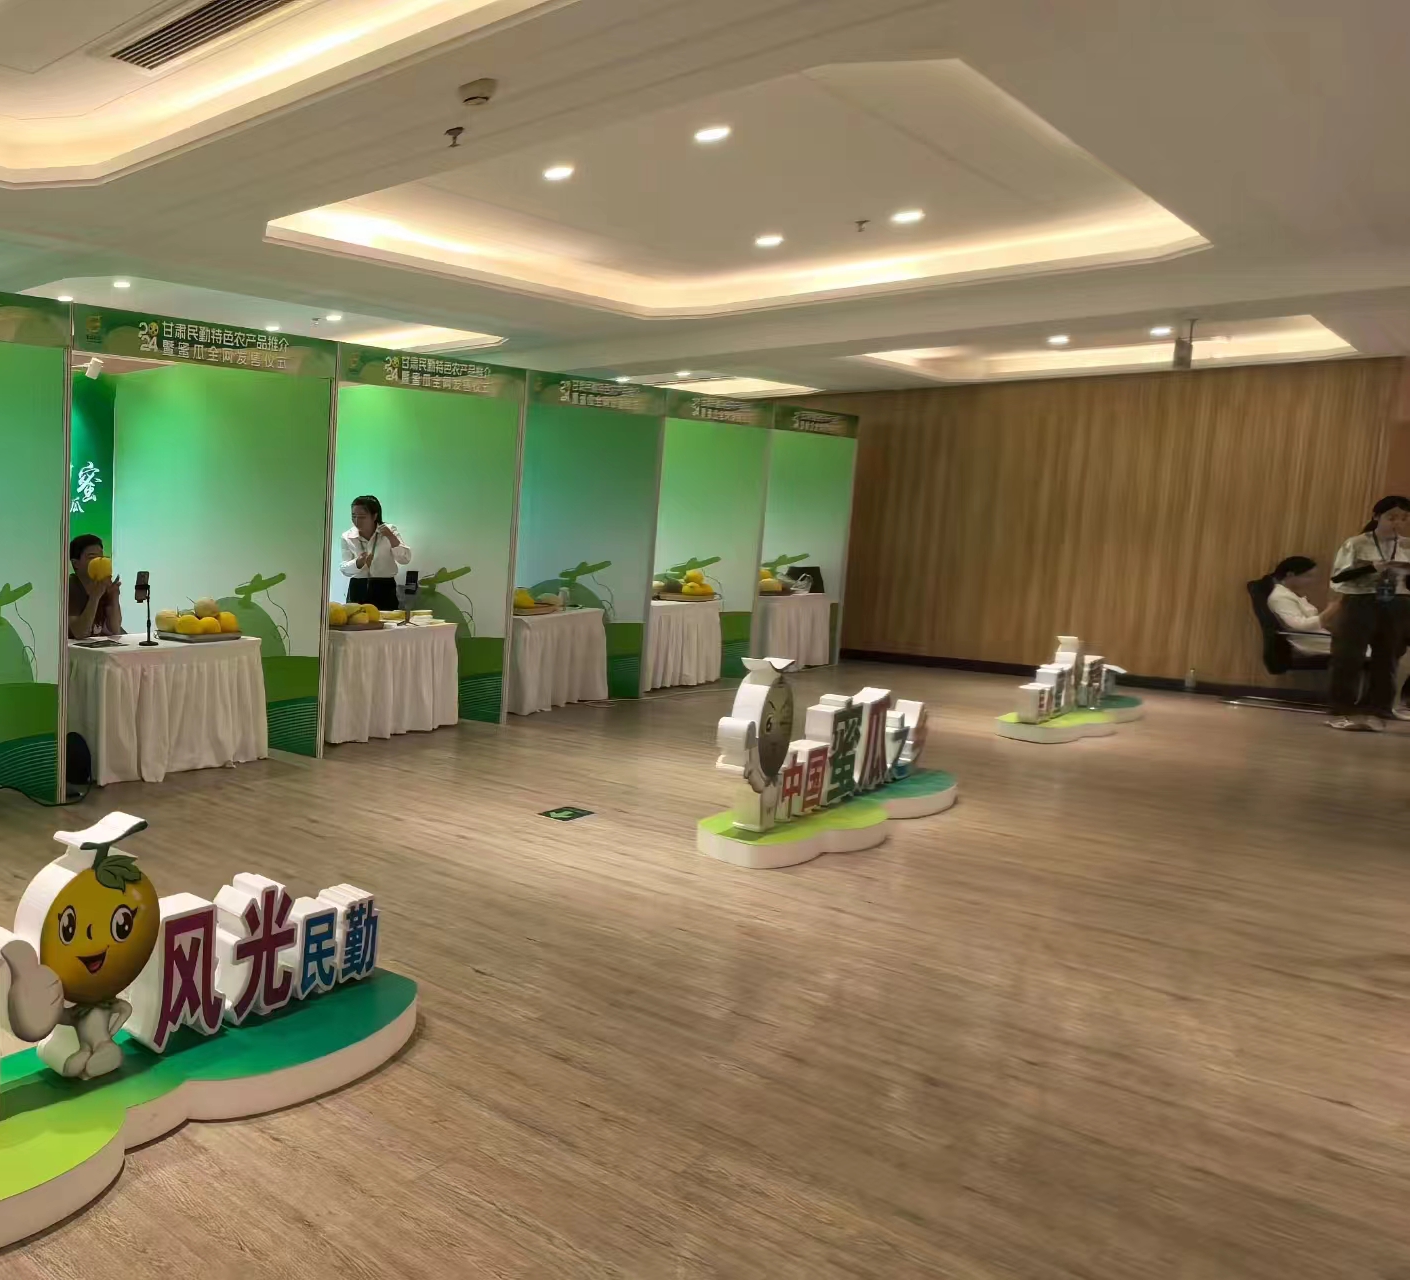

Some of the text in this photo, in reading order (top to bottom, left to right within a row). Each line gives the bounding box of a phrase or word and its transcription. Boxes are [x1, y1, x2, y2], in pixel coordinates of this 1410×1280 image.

[162, 320, 290, 353] 甘肃民勤特色农产品推介
[154, 888, 379, 1047] 风光民勤
